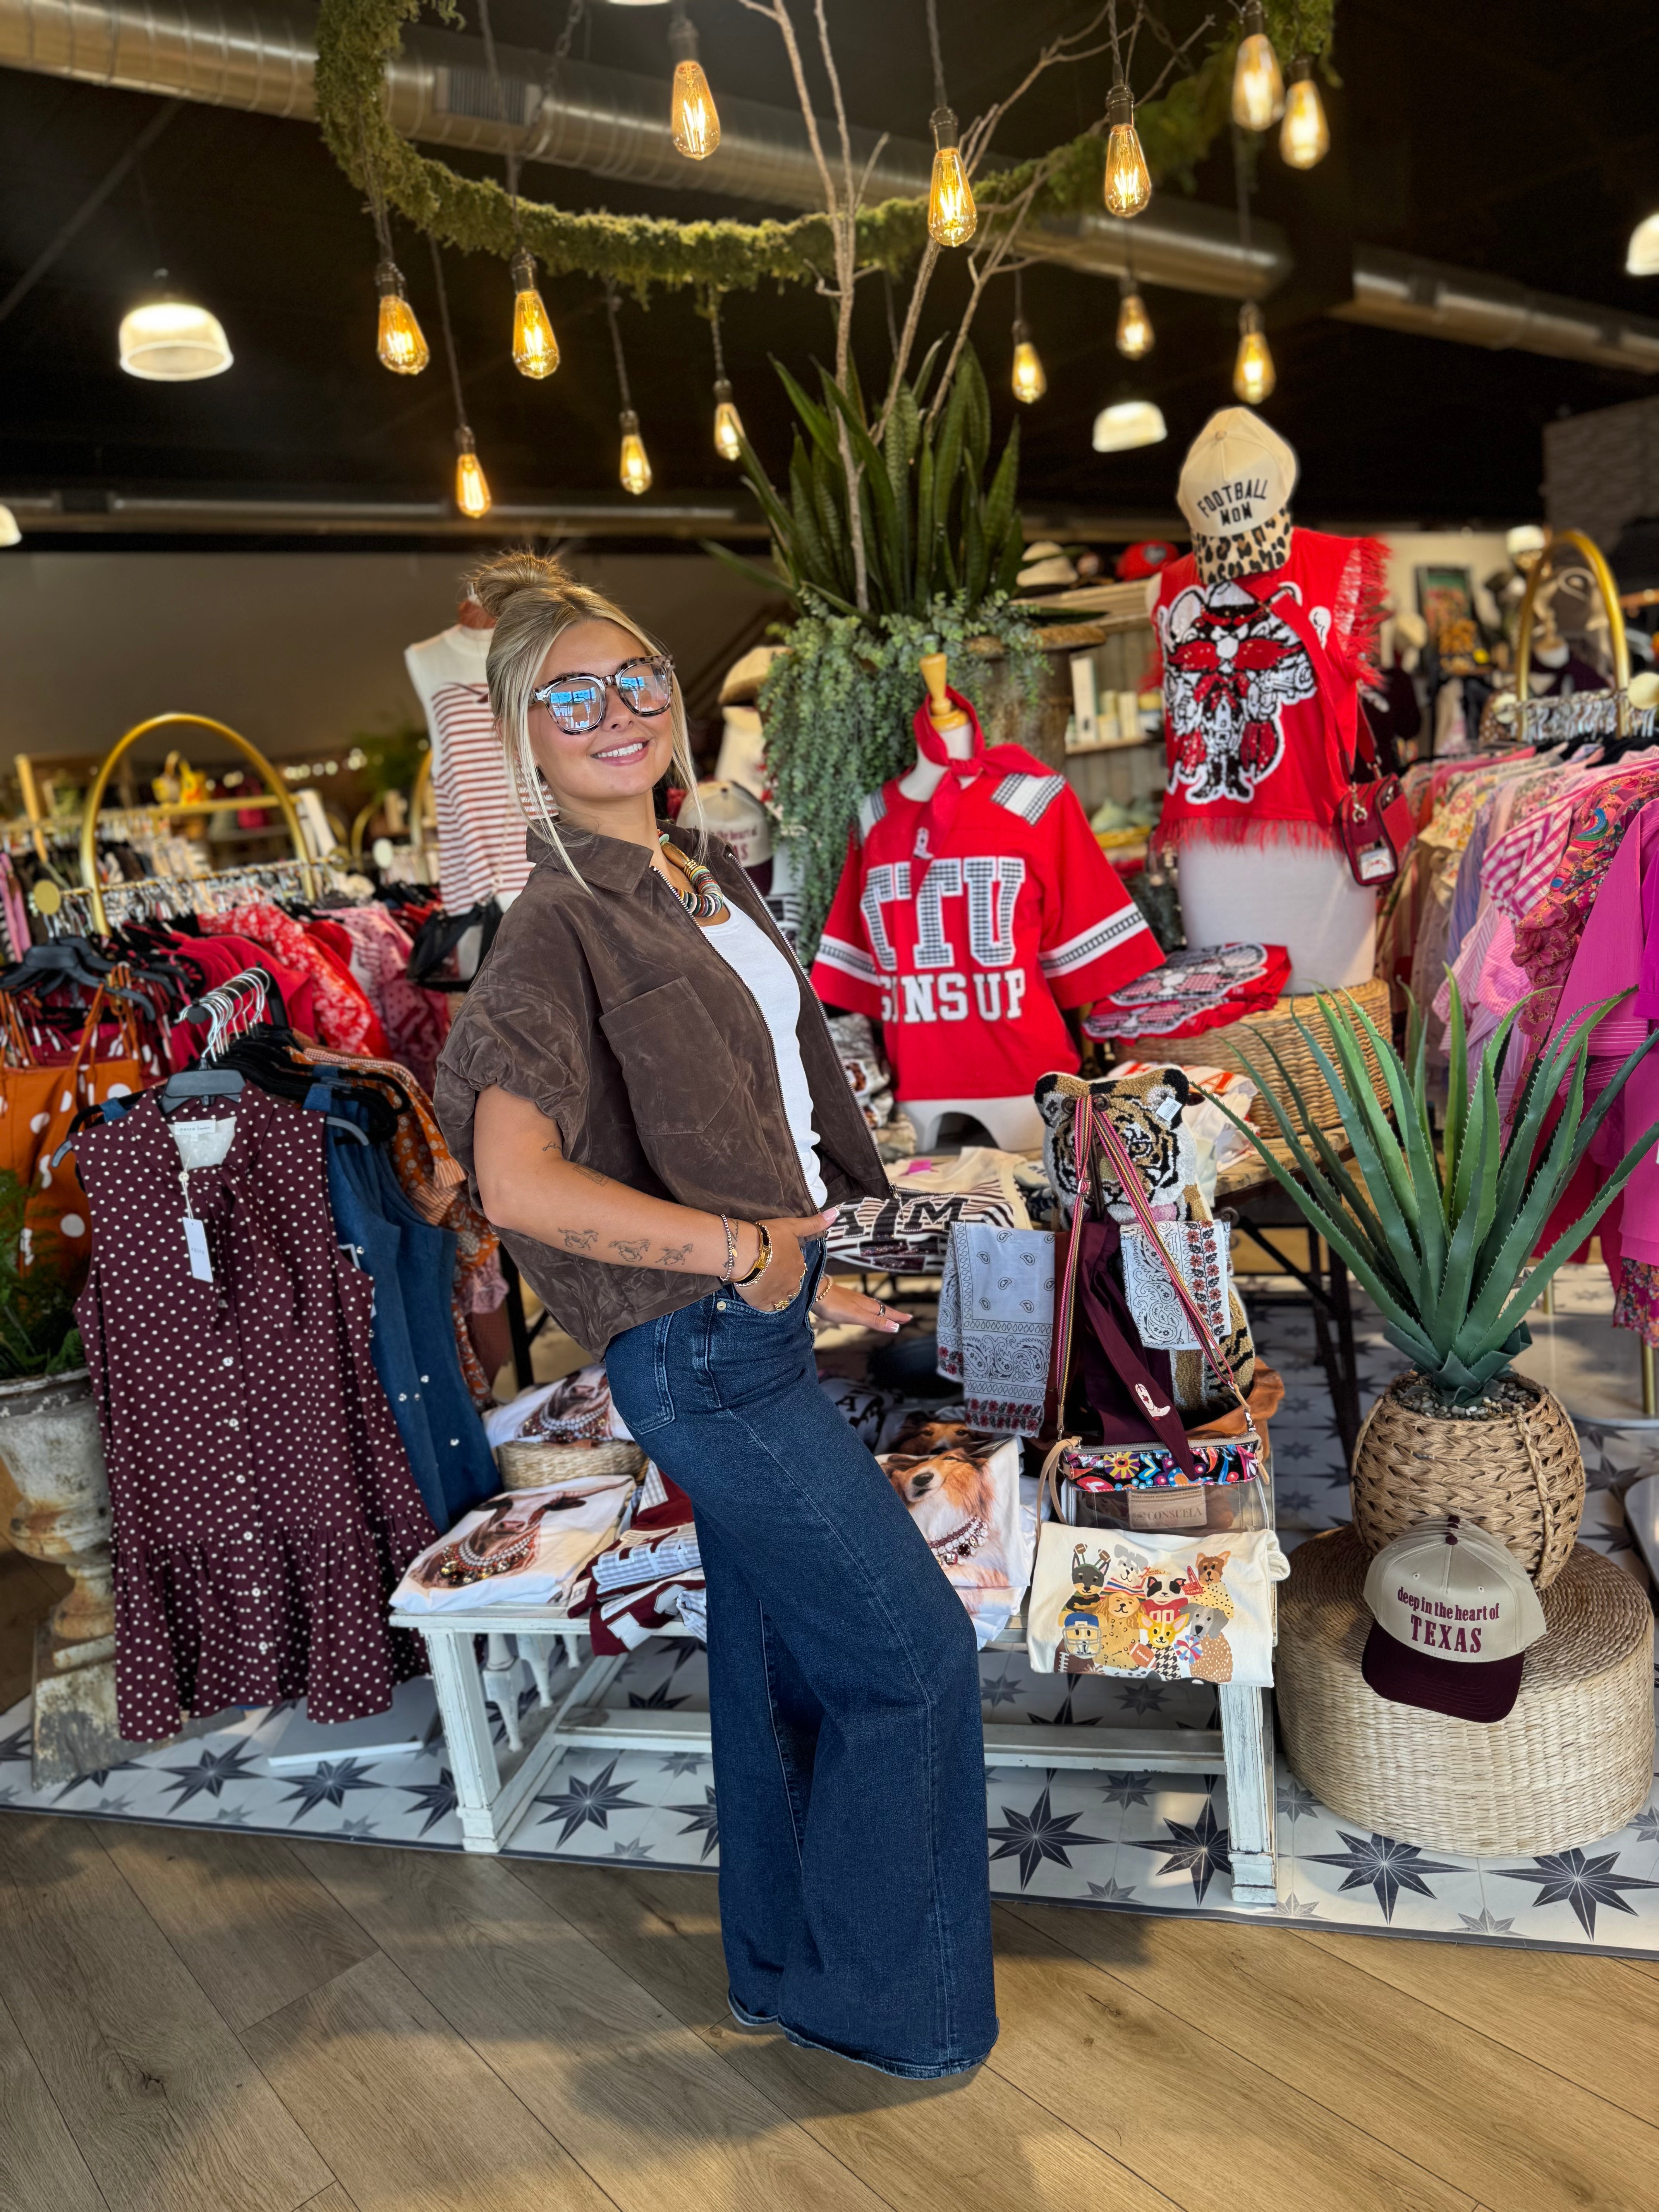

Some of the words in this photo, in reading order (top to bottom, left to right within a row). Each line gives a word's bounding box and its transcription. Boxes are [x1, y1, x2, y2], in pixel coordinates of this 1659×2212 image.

[1197, 479, 1267, 518] FOOTBALL
[1220, 501, 1252, 526] MOM
[972, 968, 1026, 1022] UP
[1147, 1508, 1202, 1520] CONSUELA
[1397, 1586, 1420, 1612] deep
[1420, 1596, 1432, 1615] in
[1434, 1602, 1453, 1619] the
[1454, 1604, 1487, 1621] heart
[1489, 1602, 1499, 1620] of
[1410, 1614, 1482, 1653] TEXAS
